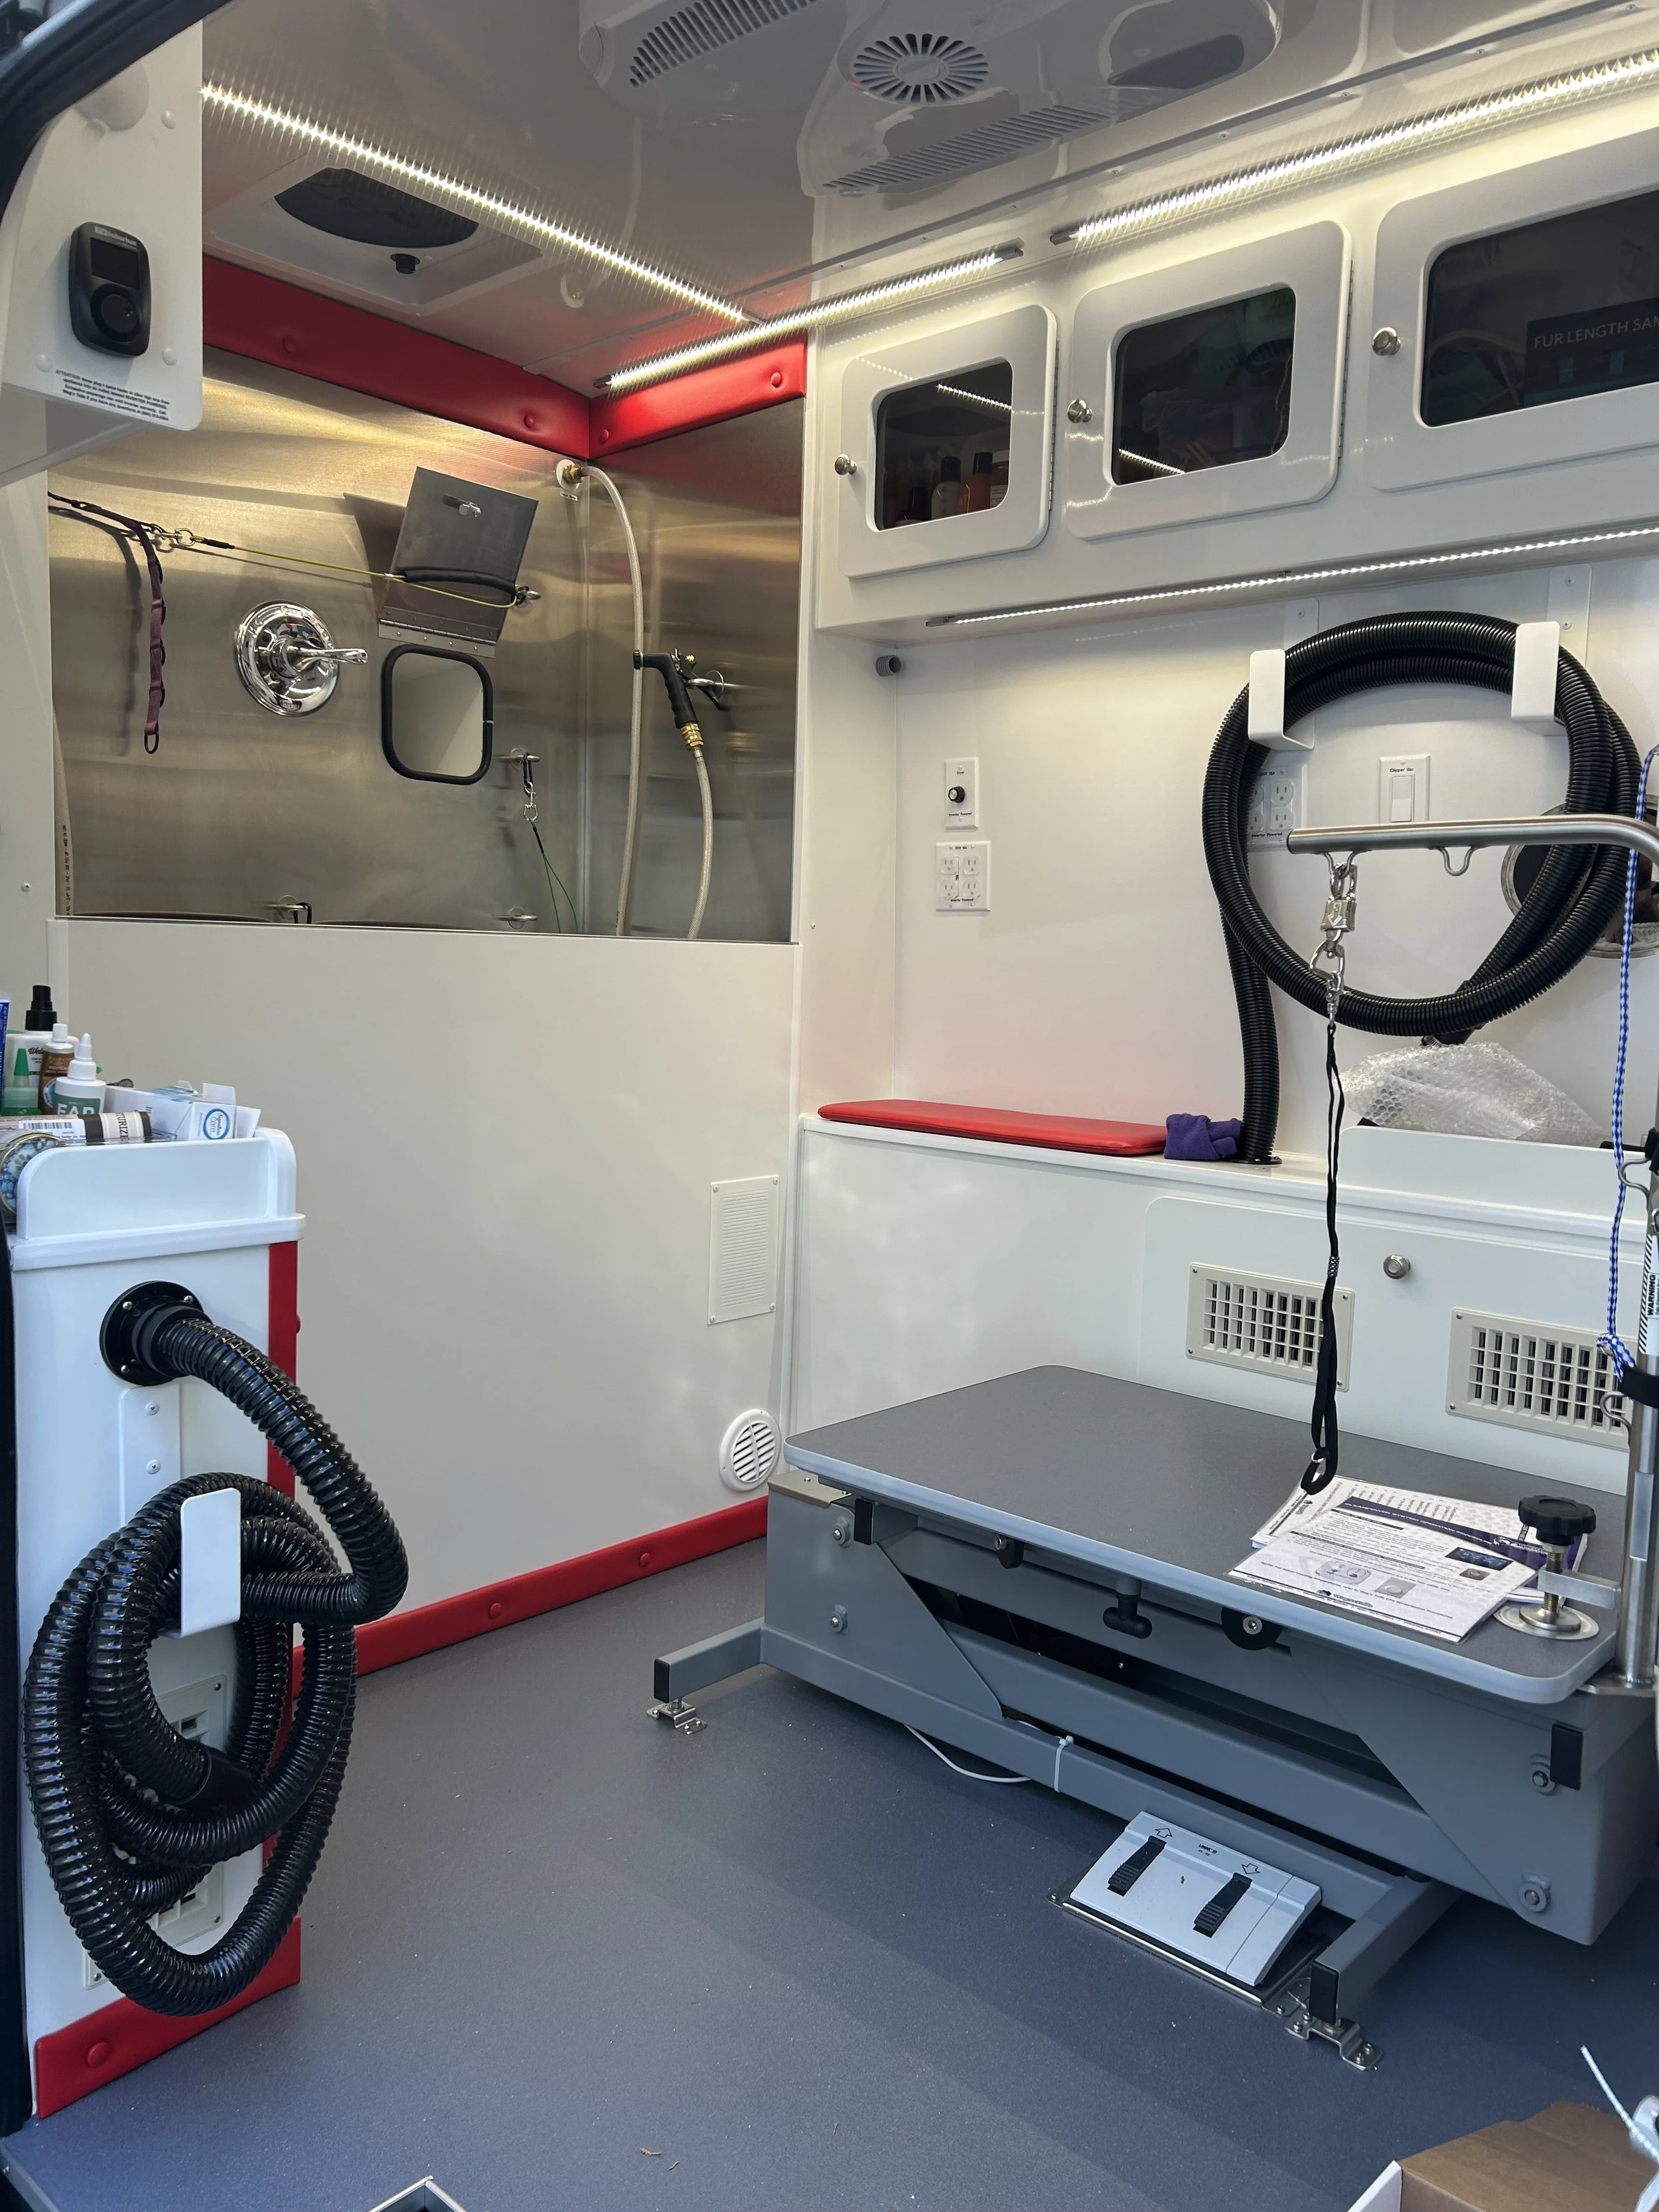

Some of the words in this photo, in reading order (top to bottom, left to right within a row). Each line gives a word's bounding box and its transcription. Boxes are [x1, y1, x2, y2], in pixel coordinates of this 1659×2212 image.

[1534, 333, 1563, 348] FUR
[1567, 321, 1628, 343] LENGTH
[1392, 1512, 1419, 1522] SYSTEM
